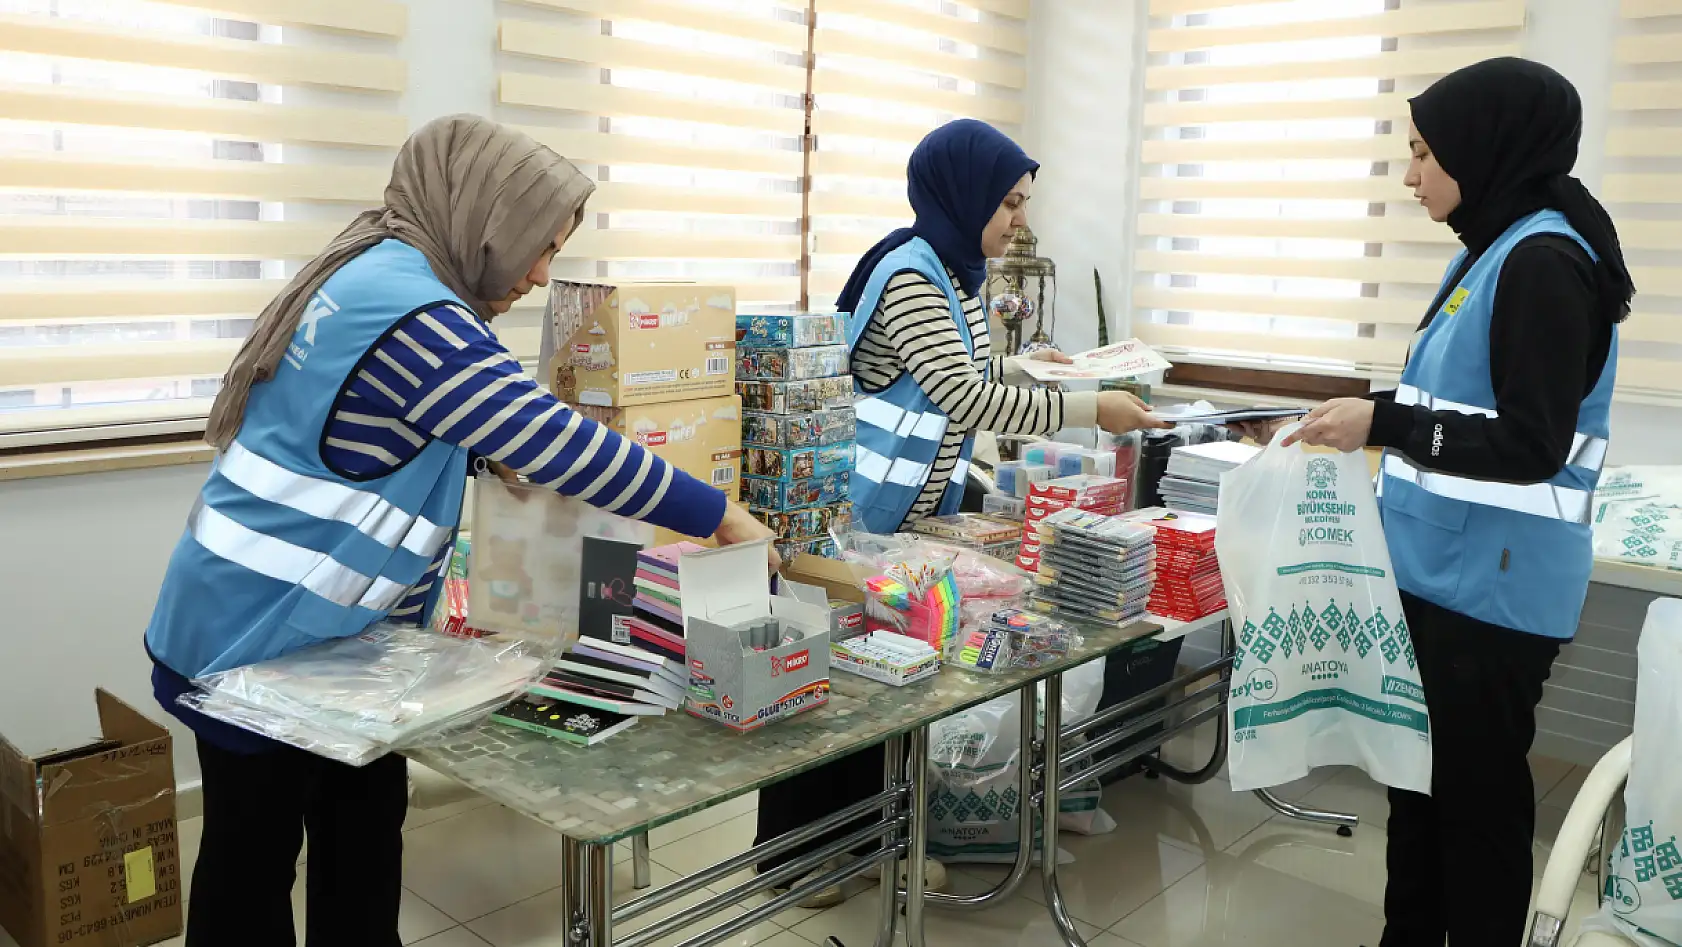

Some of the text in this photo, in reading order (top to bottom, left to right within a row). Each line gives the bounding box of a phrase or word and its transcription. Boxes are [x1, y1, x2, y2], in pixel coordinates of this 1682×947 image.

[1431, 423, 1442, 457] adidas
[1306, 490, 1337, 500] KONYA
[1307, 527, 1354, 542] KOMEK
[1301, 660, 1349, 675] ANATOYA
[757, 695, 804, 719] GLUE STICK
[145, 817, 174, 834] MADE
[59, 861, 75, 877] CM
[59, 876, 81, 892] KGS
[60, 892, 82, 908] KGS
[60, 909, 82, 926] PCS
